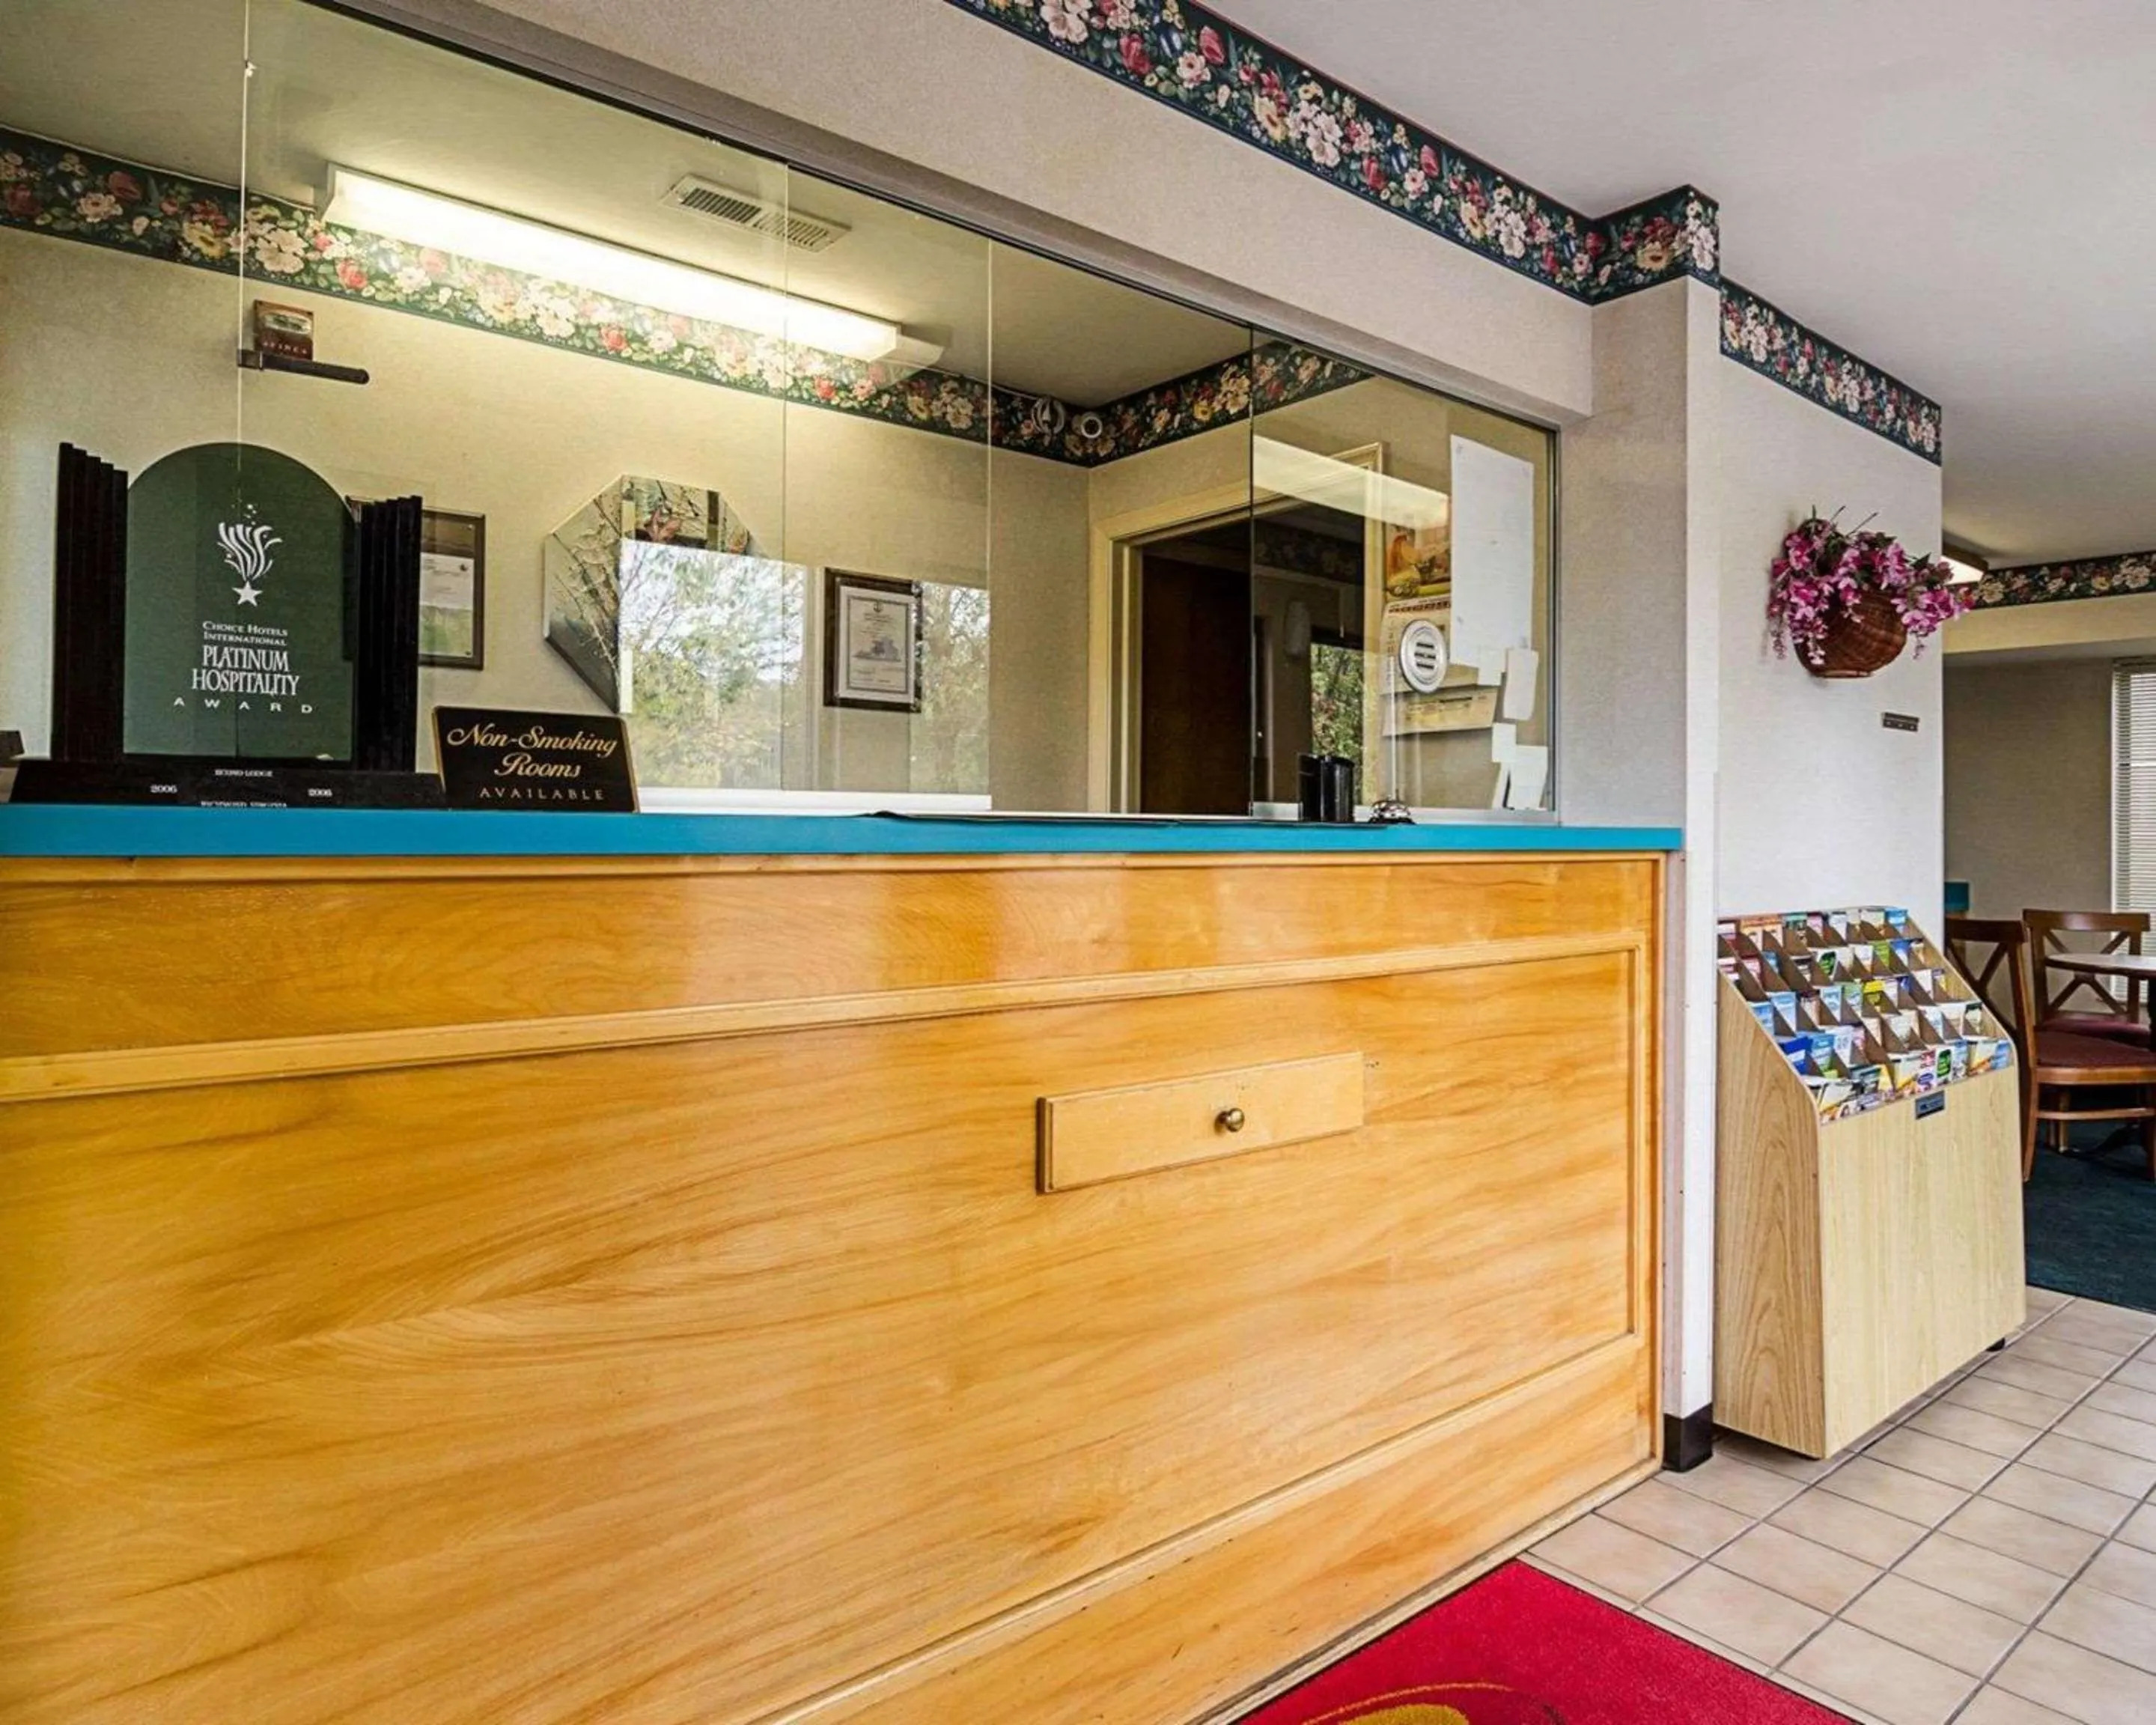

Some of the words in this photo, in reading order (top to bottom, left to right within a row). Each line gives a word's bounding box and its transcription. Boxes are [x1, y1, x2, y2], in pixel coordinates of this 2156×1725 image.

[202, 621, 244, 633] CHOICE
[248, 624, 288, 636] HOTELS
[203, 631, 287, 646] INTERNATIONAL
[203, 645, 290, 672] PLATINUM
[191, 667, 299, 696] HOSPITALITY
[447, 722, 618, 758] Non-Smoking
[494, 752, 582, 777] Rooms
[480, 788, 604, 800] AVAILABLE
